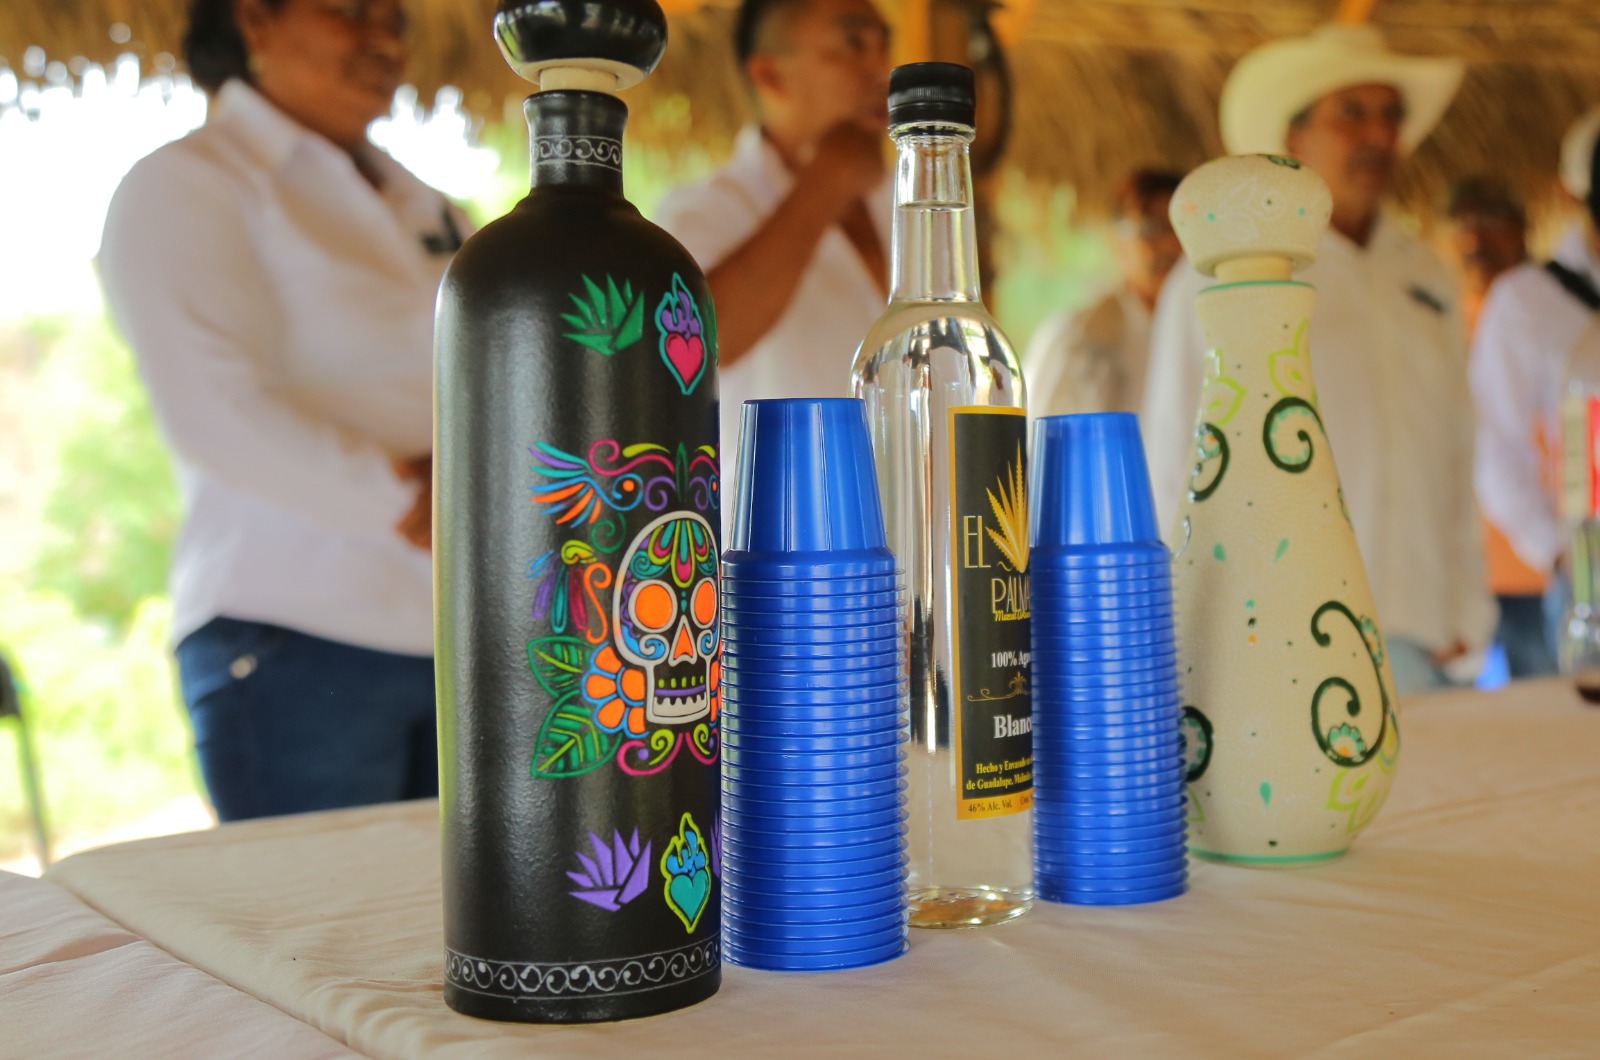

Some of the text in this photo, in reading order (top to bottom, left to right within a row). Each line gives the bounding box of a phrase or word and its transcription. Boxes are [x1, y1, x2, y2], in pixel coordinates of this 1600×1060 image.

[963, 515, 991, 569] EL
[991, 651, 1018, 668] 100%
[976, 763, 998, 774] Hecho
[998, 764, 1004, 774] y
[966, 780, 976, 790] de
[968, 802, 986, 813] 46%
[987, 801, 1001, 812] Alc.
